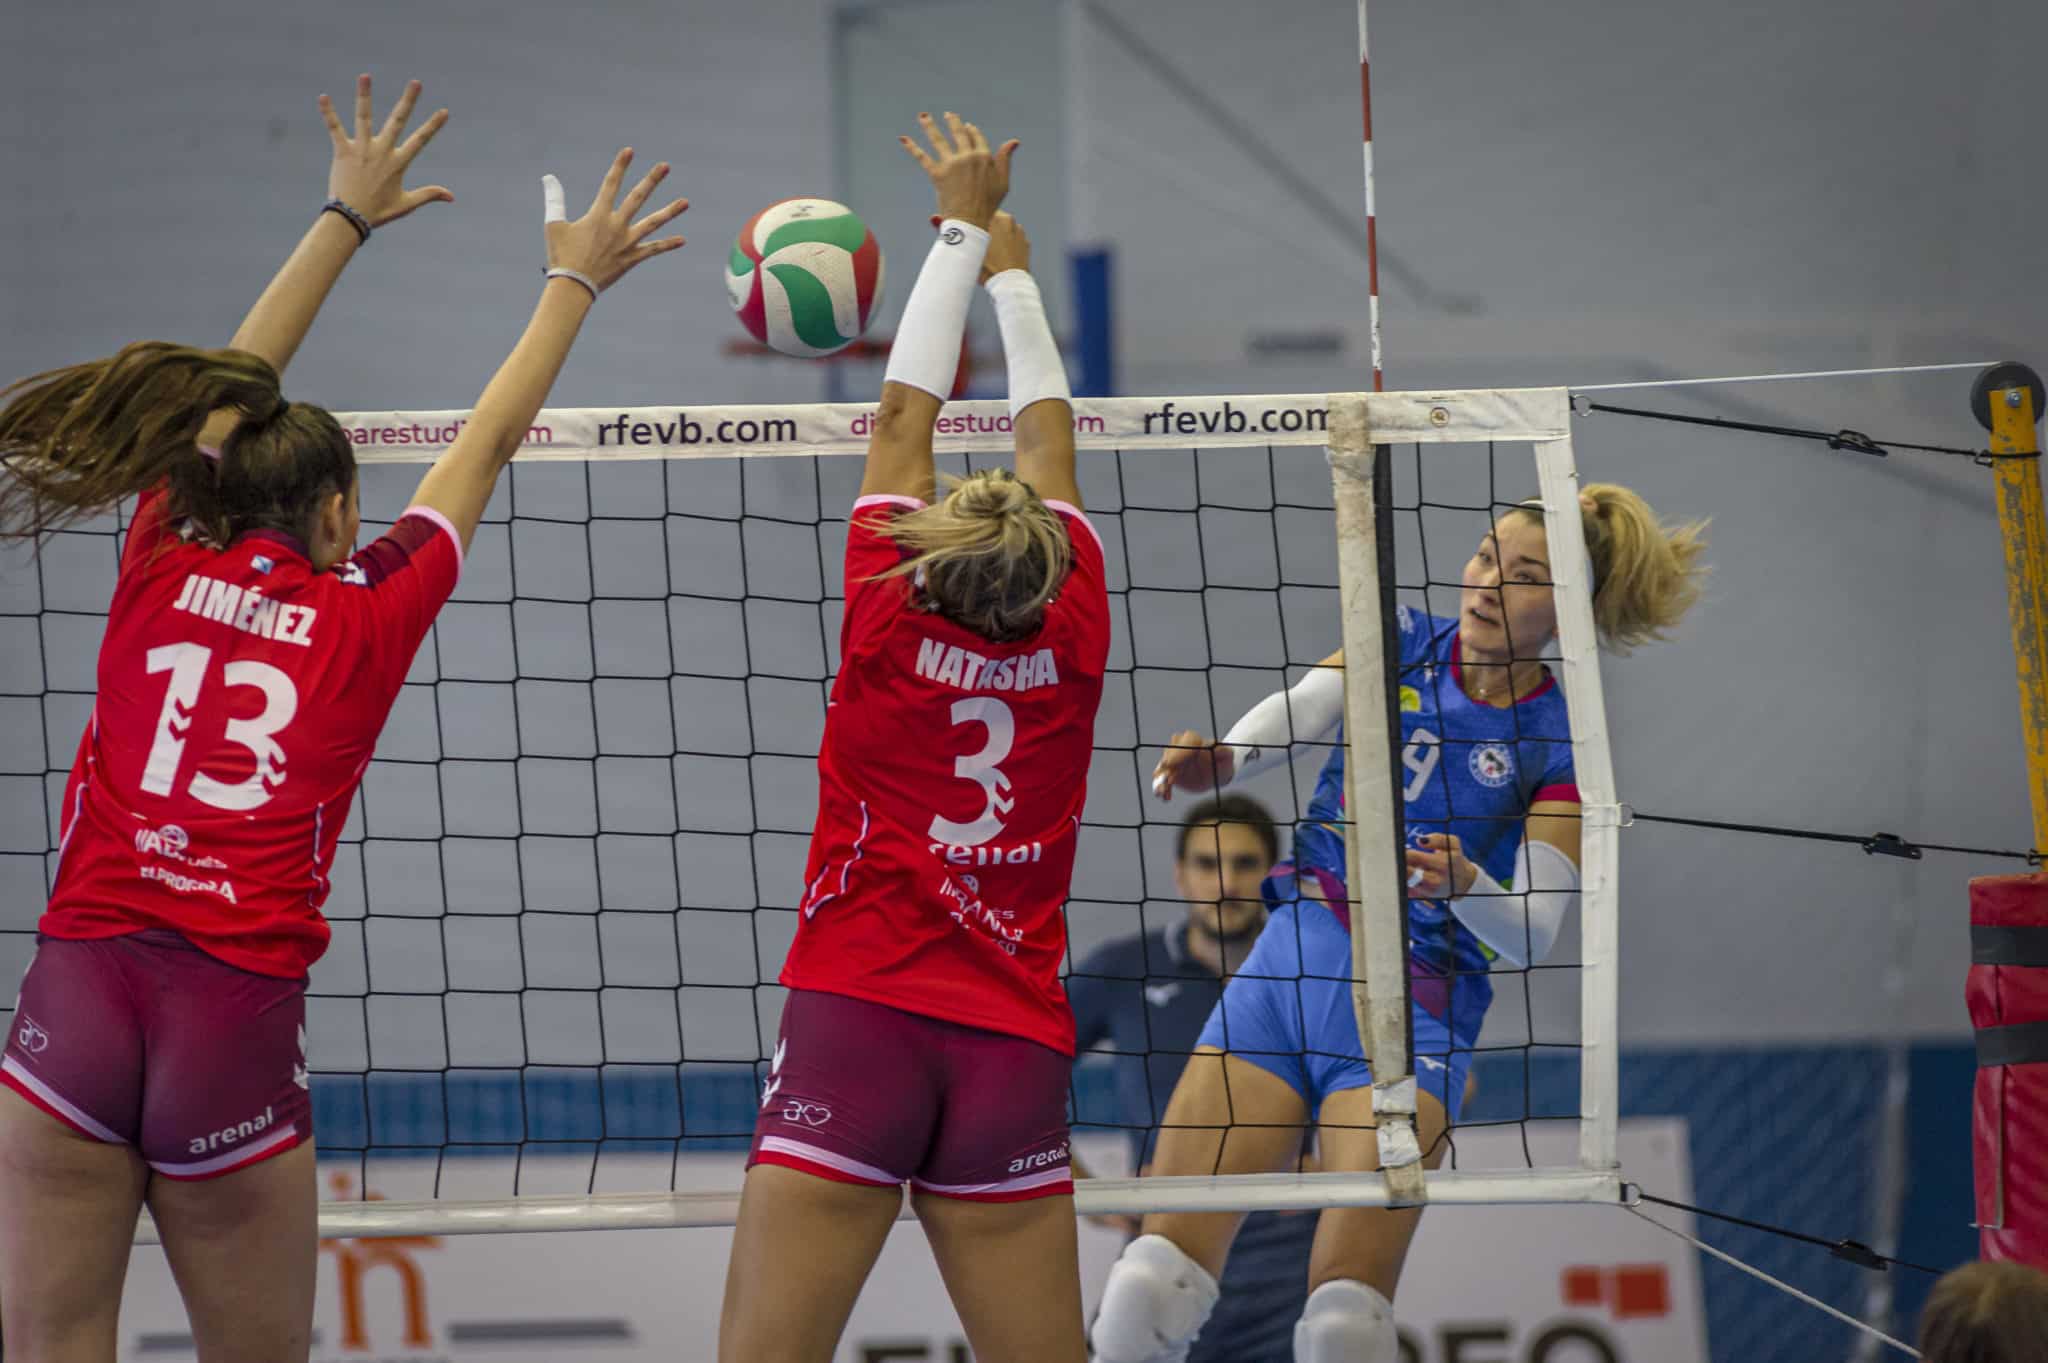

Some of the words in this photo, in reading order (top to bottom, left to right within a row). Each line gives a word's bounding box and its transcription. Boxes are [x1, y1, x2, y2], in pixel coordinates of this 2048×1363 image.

[598, 413, 797, 446] rfevb.com
[173, 574, 317, 647] JIMÉNEZ
[915, 637, 1060, 692] NATASHA
[139, 641, 298, 811] 13
[927, 696, 1016, 846] 3
[189, 1106, 274, 1155] arenal
